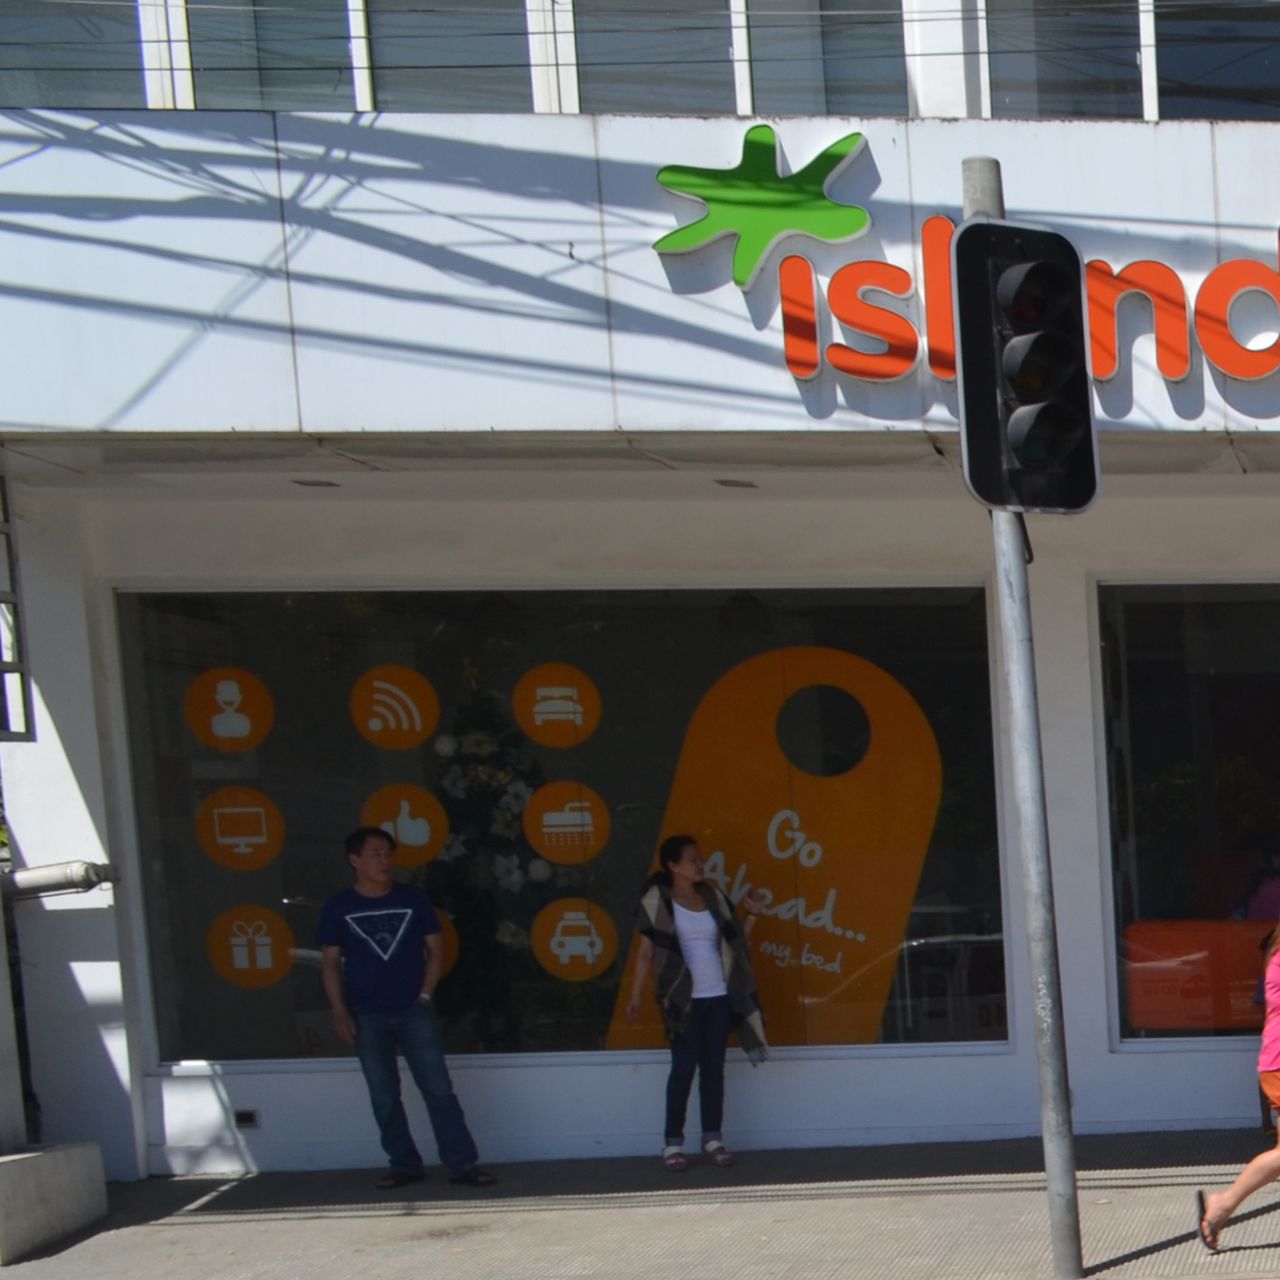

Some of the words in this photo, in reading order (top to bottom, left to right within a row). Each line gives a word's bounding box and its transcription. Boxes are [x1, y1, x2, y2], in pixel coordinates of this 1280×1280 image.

[768, 809, 823, 868] Go
[759, 939, 792, 969] my
[800, 942, 843, 975] bed
